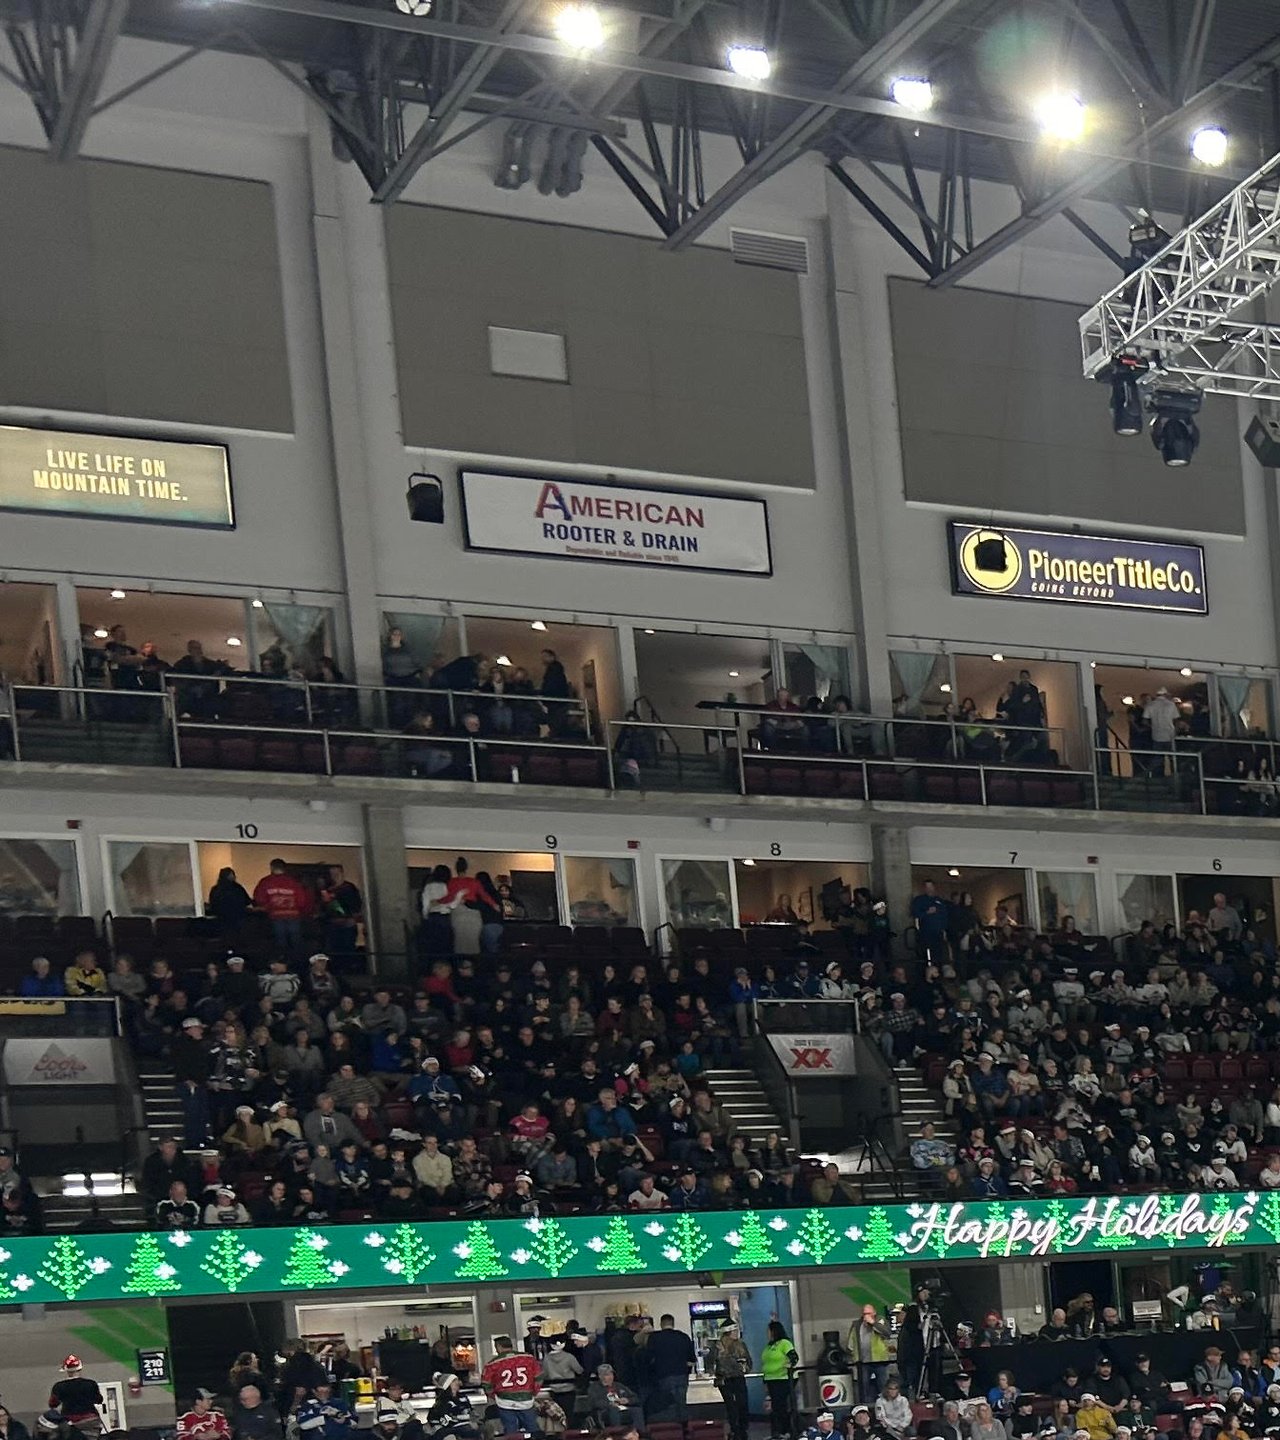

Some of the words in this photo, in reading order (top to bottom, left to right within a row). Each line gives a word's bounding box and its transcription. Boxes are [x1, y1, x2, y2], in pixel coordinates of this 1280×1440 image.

[47, 449, 89, 470] LIVE
[94, 453, 135, 475] LIFE
[141, 458, 166, 477] ON
[33, 470, 130, 496] MOUNTAIN
[135, 479, 188, 501] TIME.
[535, 482, 705, 528] AMERICAN
[543, 522, 616, 545] ROOTER
[623, 530, 635, 547] &
[643, 532, 699, 552] DRAIN
[1028, 549, 1201, 595] PioneerTitleCo.
[1031, 582, 1065, 595] GOING
[1073, 585, 1114, 599] BEYOND
[235, 823, 258, 839] 10
[545, 834, 558, 849] 9
[770, 842, 782, 857] 8
[1009, 851, 1018, 864] 7
[1212, 858, 1223, 872] 6
[790, 1048, 834, 1069] XX
[904, 1200, 1060, 1259] Happy
[1065, 1193, 1254, 1248] Holidays
[502, 1367, 528, 1388] 25
